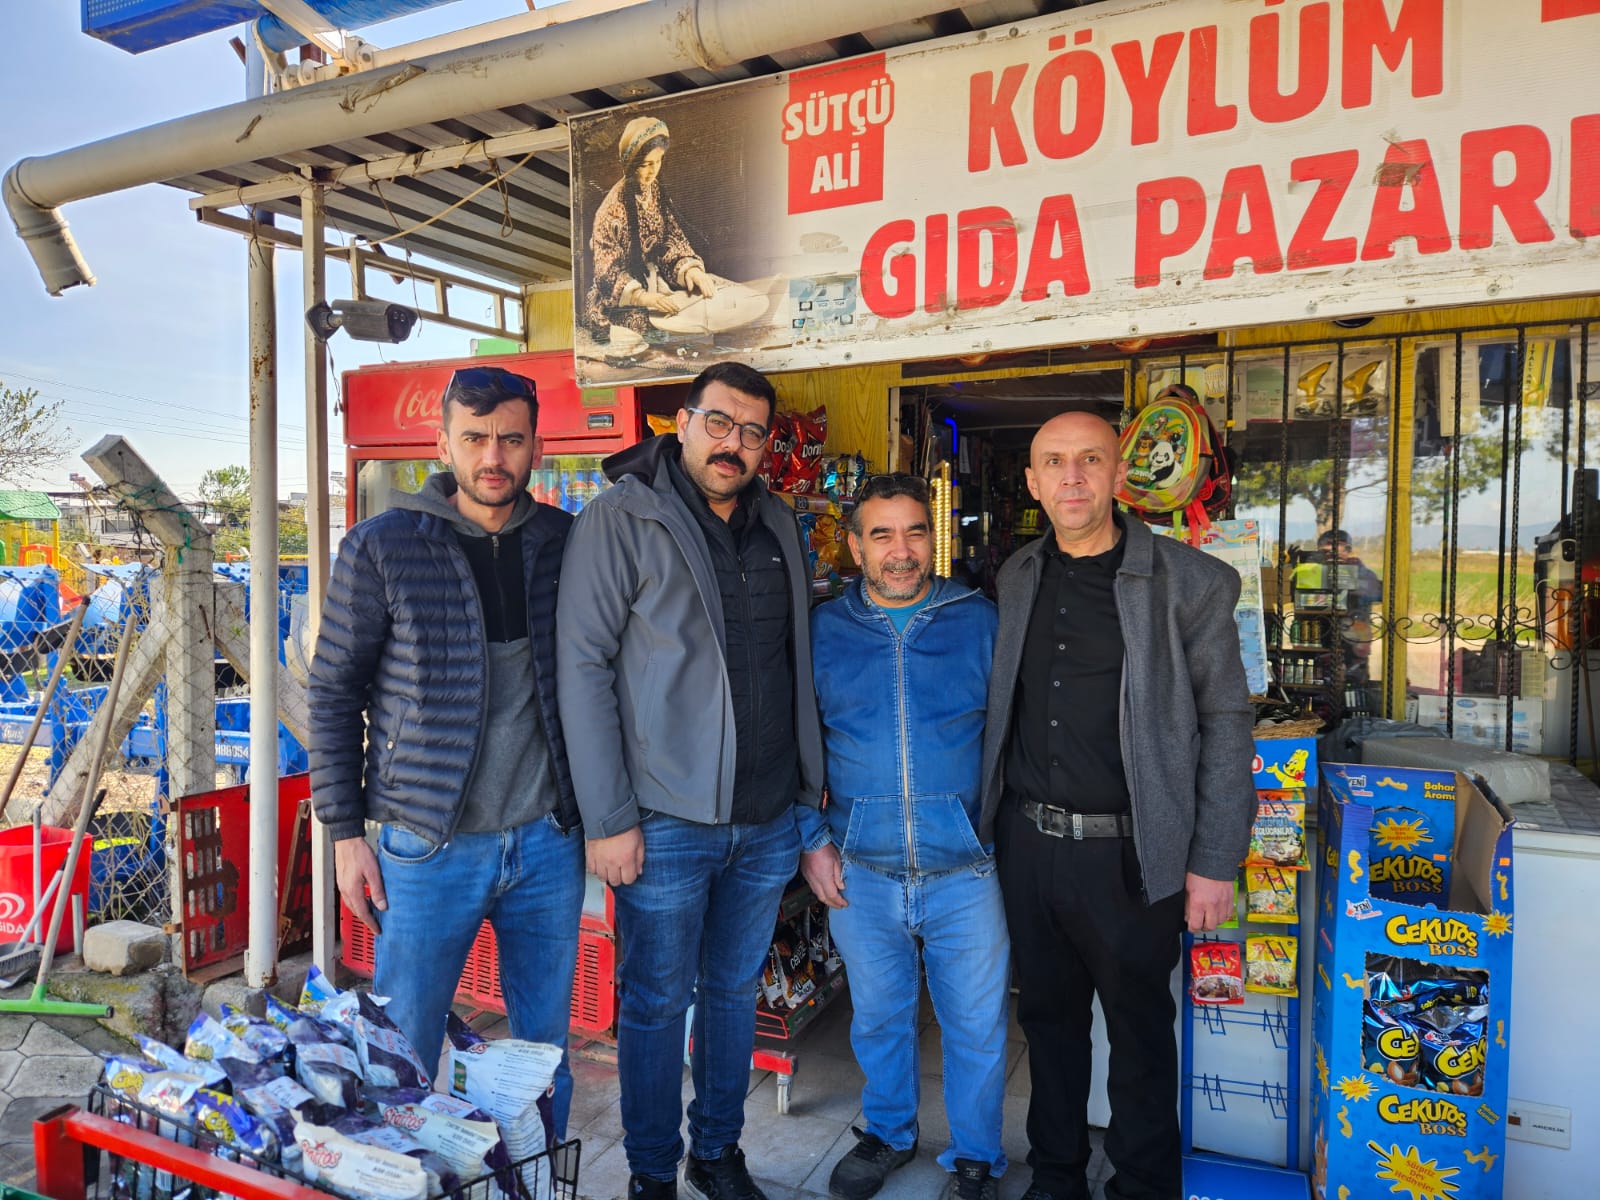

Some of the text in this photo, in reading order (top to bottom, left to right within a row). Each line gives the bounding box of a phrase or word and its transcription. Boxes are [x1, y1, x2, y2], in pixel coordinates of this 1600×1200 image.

[968, 0, 1443, 172] KÖYLÜM
[784, 77, 892, 141] SÜTÇÜ
[810, 142, 860, 194] ALİ
[860, 193, 1091, 319] GIDA
[1369, 855, 1443, 884] EKUTOS
[1392, 881, 1443, 894] BOSS
[1385, 915, 1479, 949] CEKUTOS
[1428, 943, 1479, 957] BOSS
[1378, 1095, 1468, 1128] CEKUTOS
[1419, 1122, 1468, 1137] BOSS
